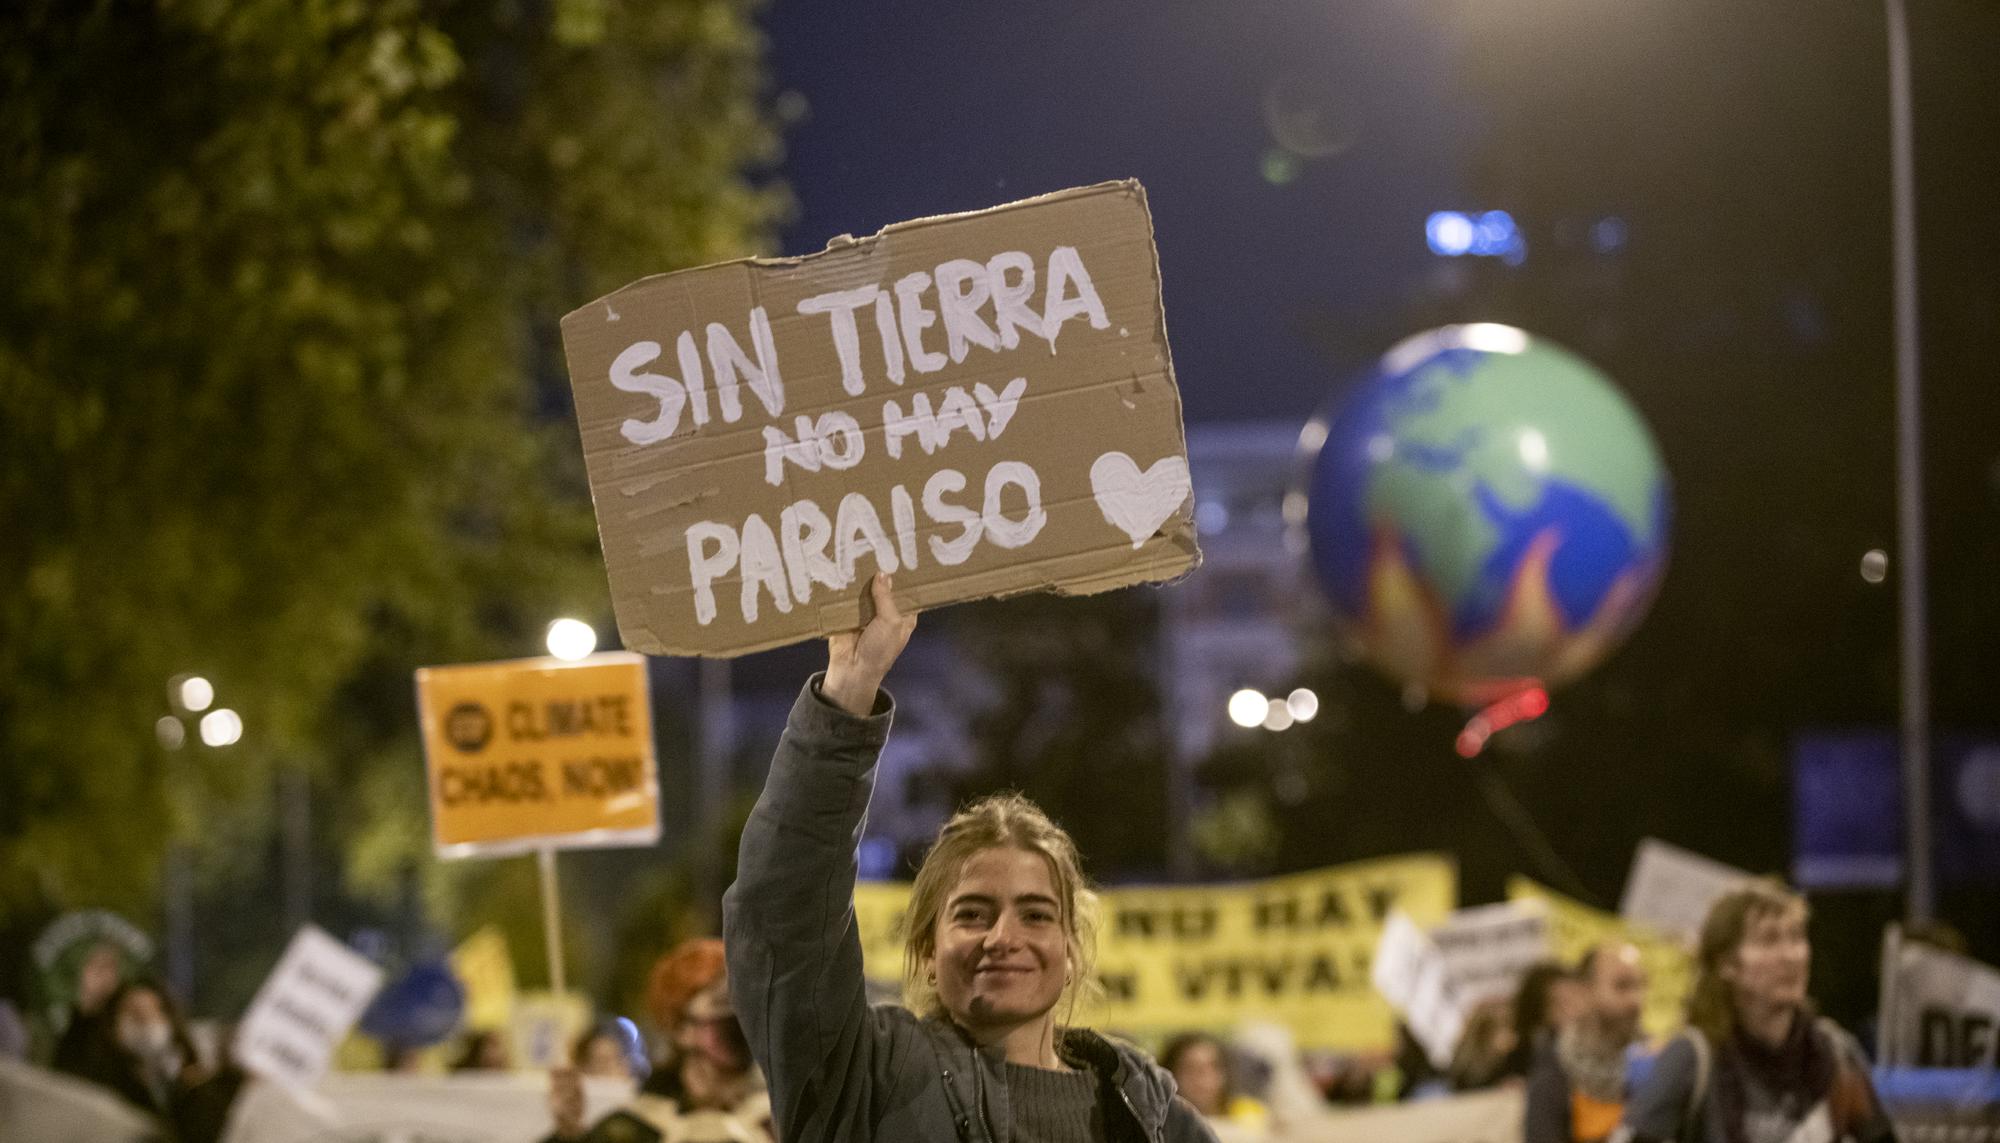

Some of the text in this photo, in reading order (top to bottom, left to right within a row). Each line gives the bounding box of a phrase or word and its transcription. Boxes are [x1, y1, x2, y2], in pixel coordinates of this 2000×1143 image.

[609, 246, 1111, 446] SIN TIERRA
[763, 377, 1027, 486] NO HAY
[685, 461, 1047, 625] PARAISO
[506, 694, 633, 743] CLIMATE
